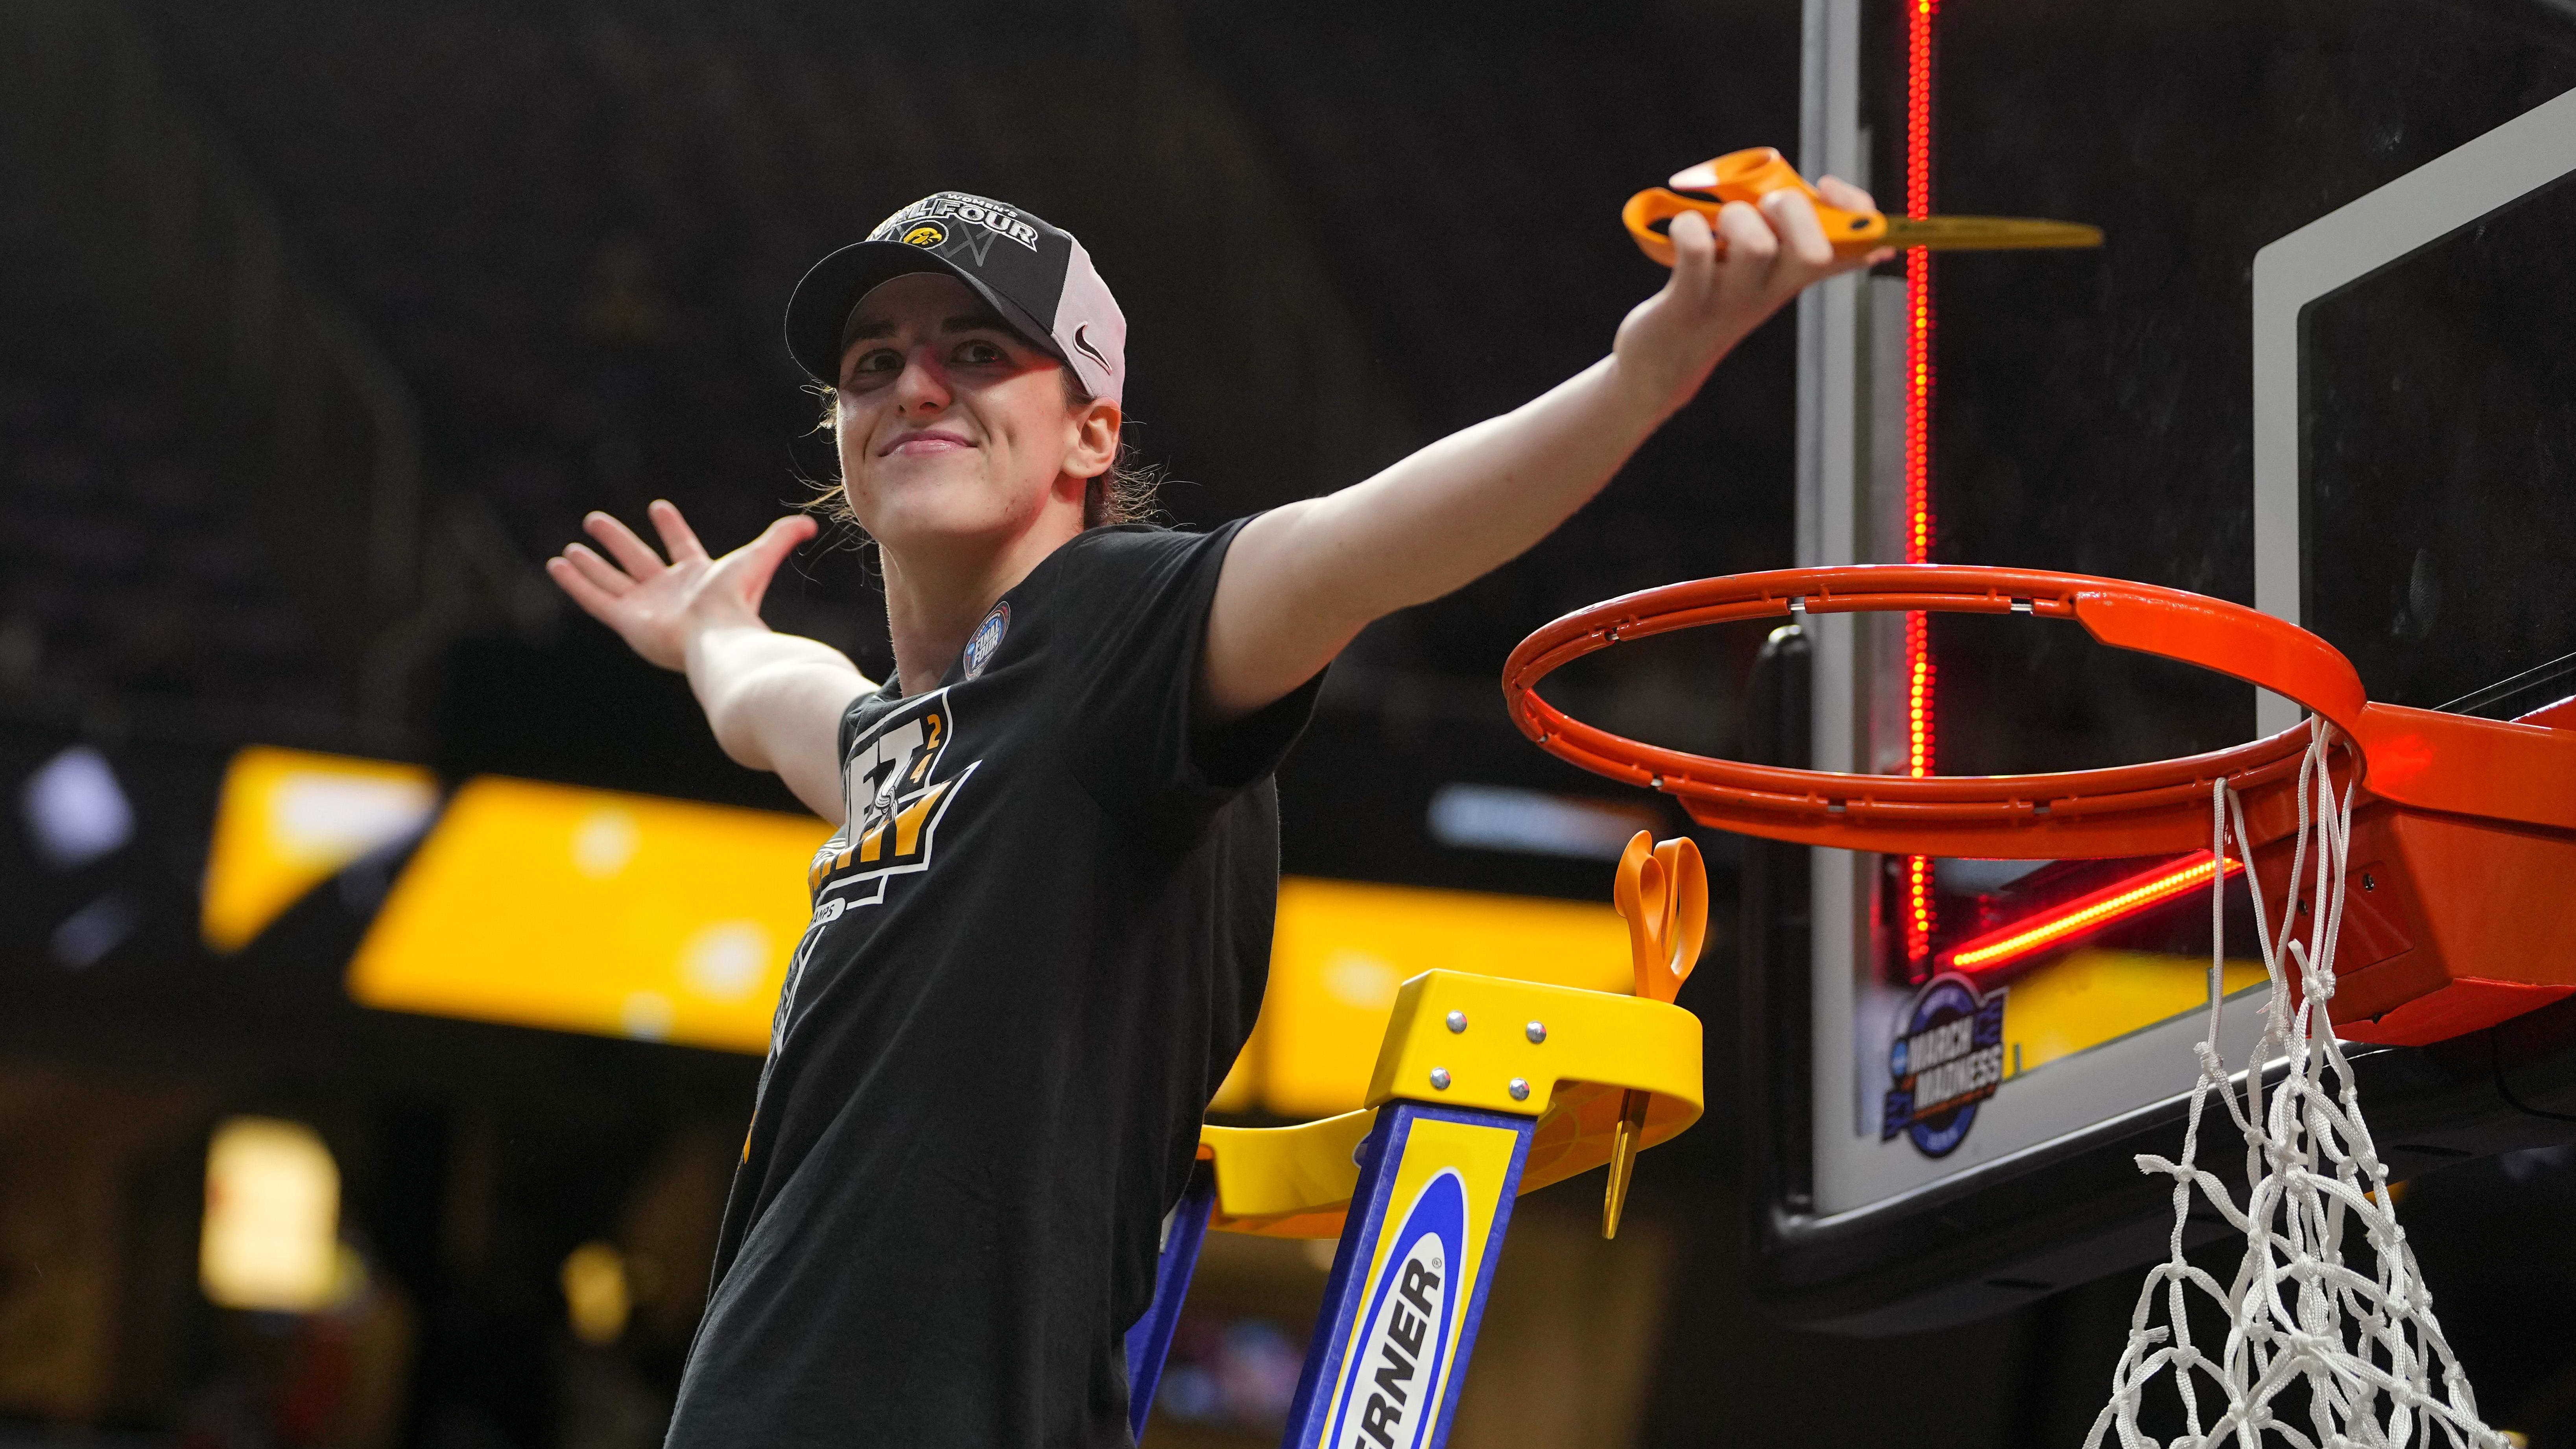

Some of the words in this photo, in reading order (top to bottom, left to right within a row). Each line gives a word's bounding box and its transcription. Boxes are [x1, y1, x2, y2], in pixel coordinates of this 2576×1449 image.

[933, 199, 1035, 245] FOUR
[947, 193, 1018, 218] WOMEN'S
[972, 633, 998, 668] FOUR
[975, 618, 1000, 653] FINAL
[1909, 1016, 1973, 1074] MARCH
[1914, 1044, 2002, 1109] MADNESS
